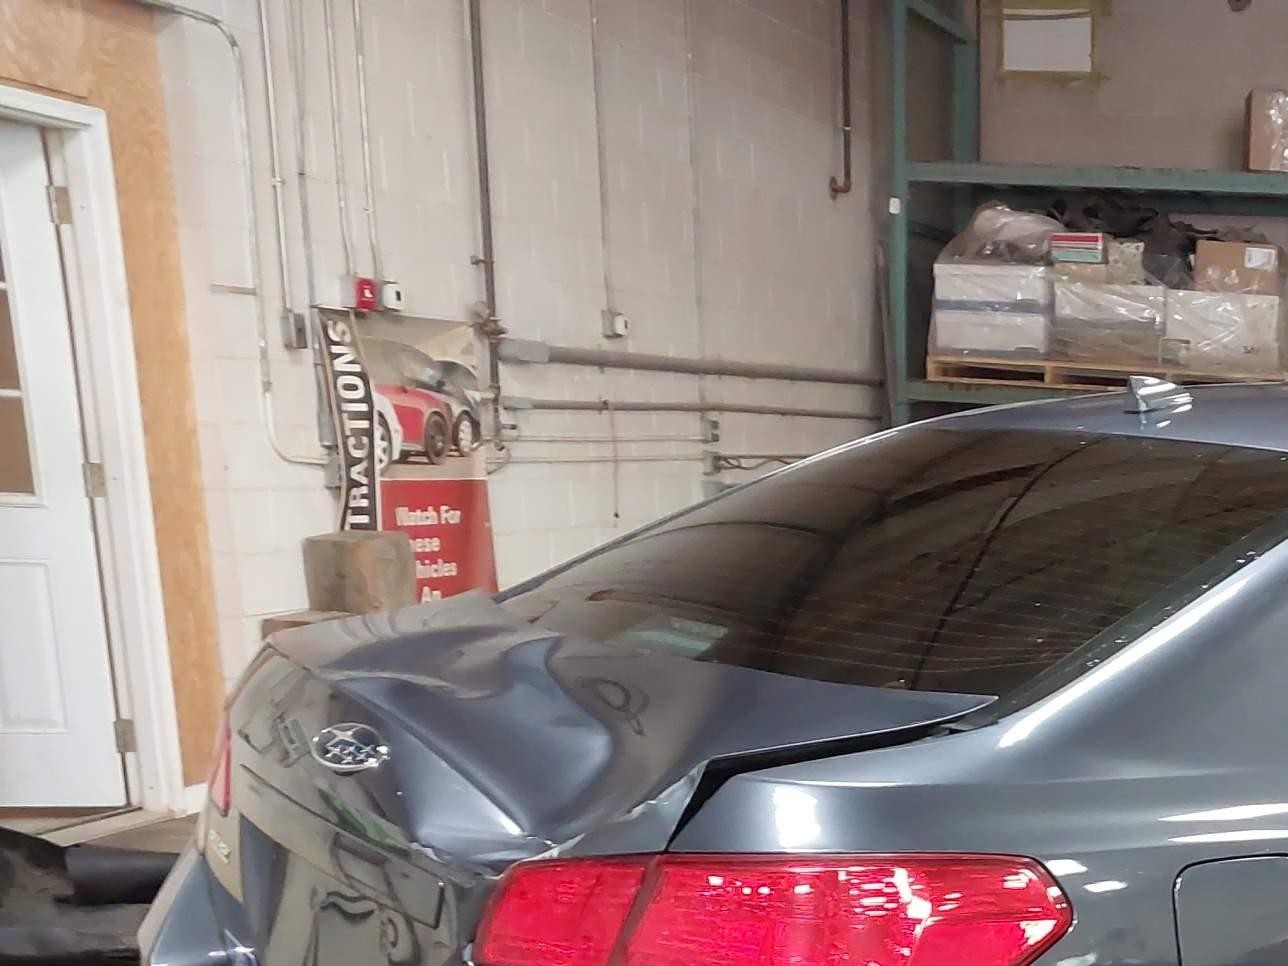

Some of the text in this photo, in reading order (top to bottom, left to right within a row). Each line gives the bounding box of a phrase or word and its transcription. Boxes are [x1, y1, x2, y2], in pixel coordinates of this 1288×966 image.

[326, 319, 373, 532] TRACTIONS
[395, 505, 461, 526] Watch For
